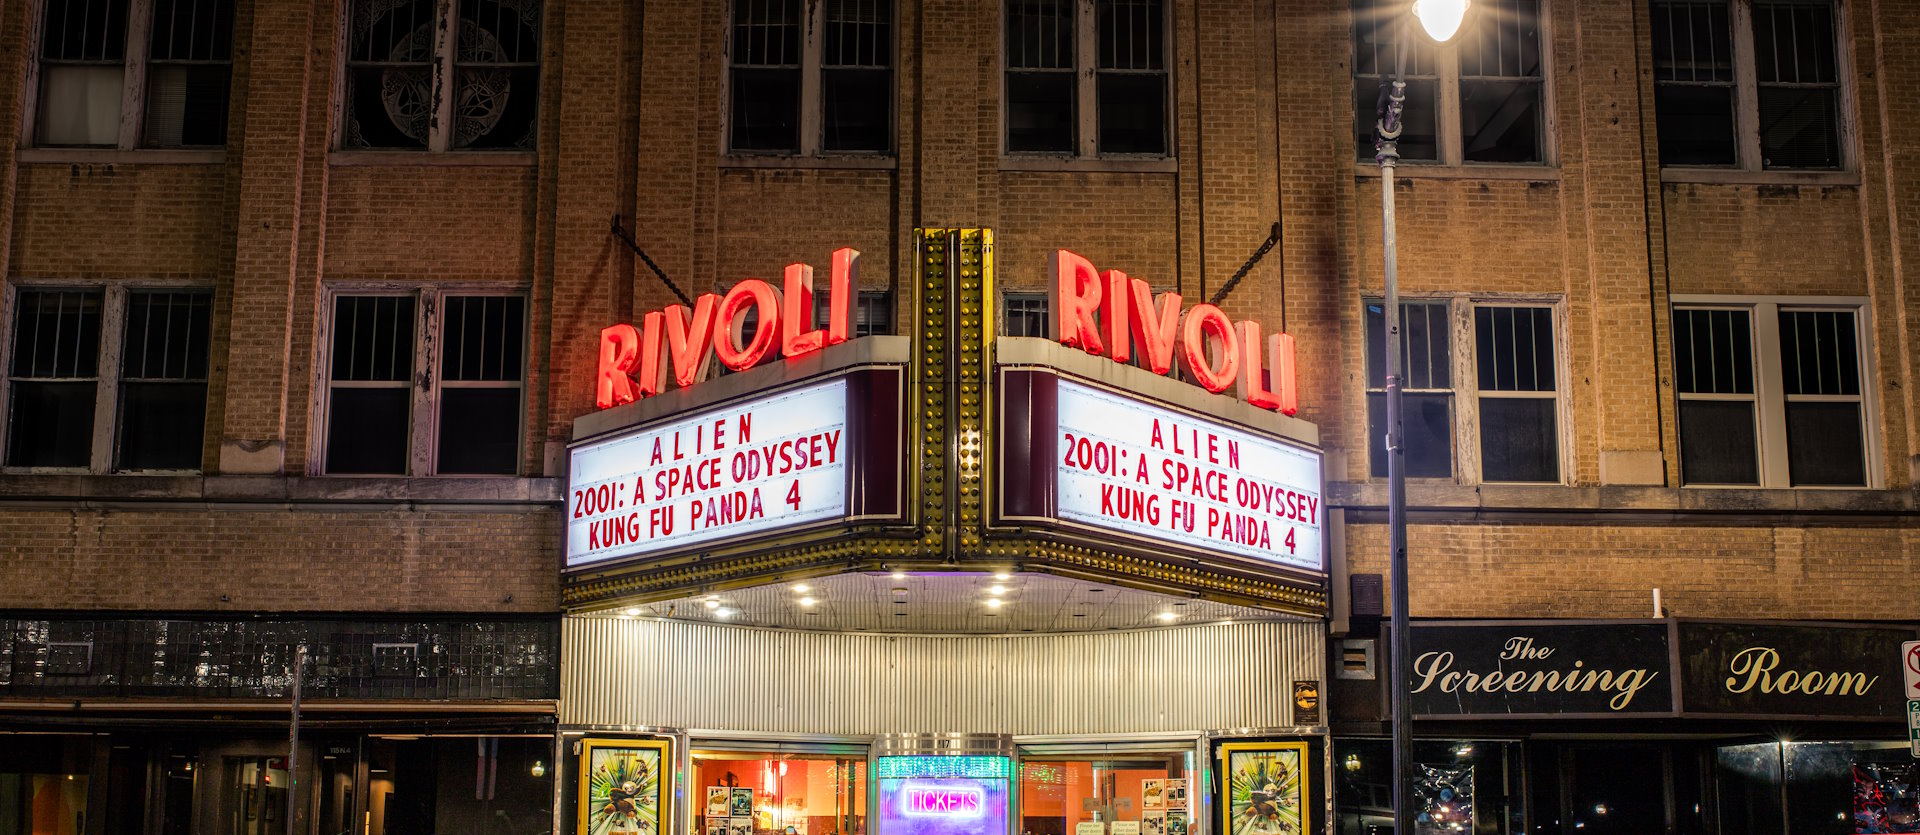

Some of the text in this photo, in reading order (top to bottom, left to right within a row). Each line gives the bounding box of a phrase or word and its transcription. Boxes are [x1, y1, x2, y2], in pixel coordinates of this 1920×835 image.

[596, 247, 860, 408] RIVOLI
[1048, 249, 1298, 416] RIVOLI
[651, 412, 752, 467] ALIEN
[1151, 418, 1240, 470] ALIEN
[574, 429, 841, 519] 2001: A SPACE ODYSSEY
[1063, 433, 1318, 525] 2001: A SPACE ODYSSEY
[588, 479, 801, 551] KUNG FU PANDA 4
[1101, 482, 1297, 555] KUNG FU PANDA 4
[1411, 651, 1658, 710] Screening
[1500, 636, 1554, 660] The
[1726, 647, 1878, 696] Room
[908, 789, 979, 813] TICKETS
